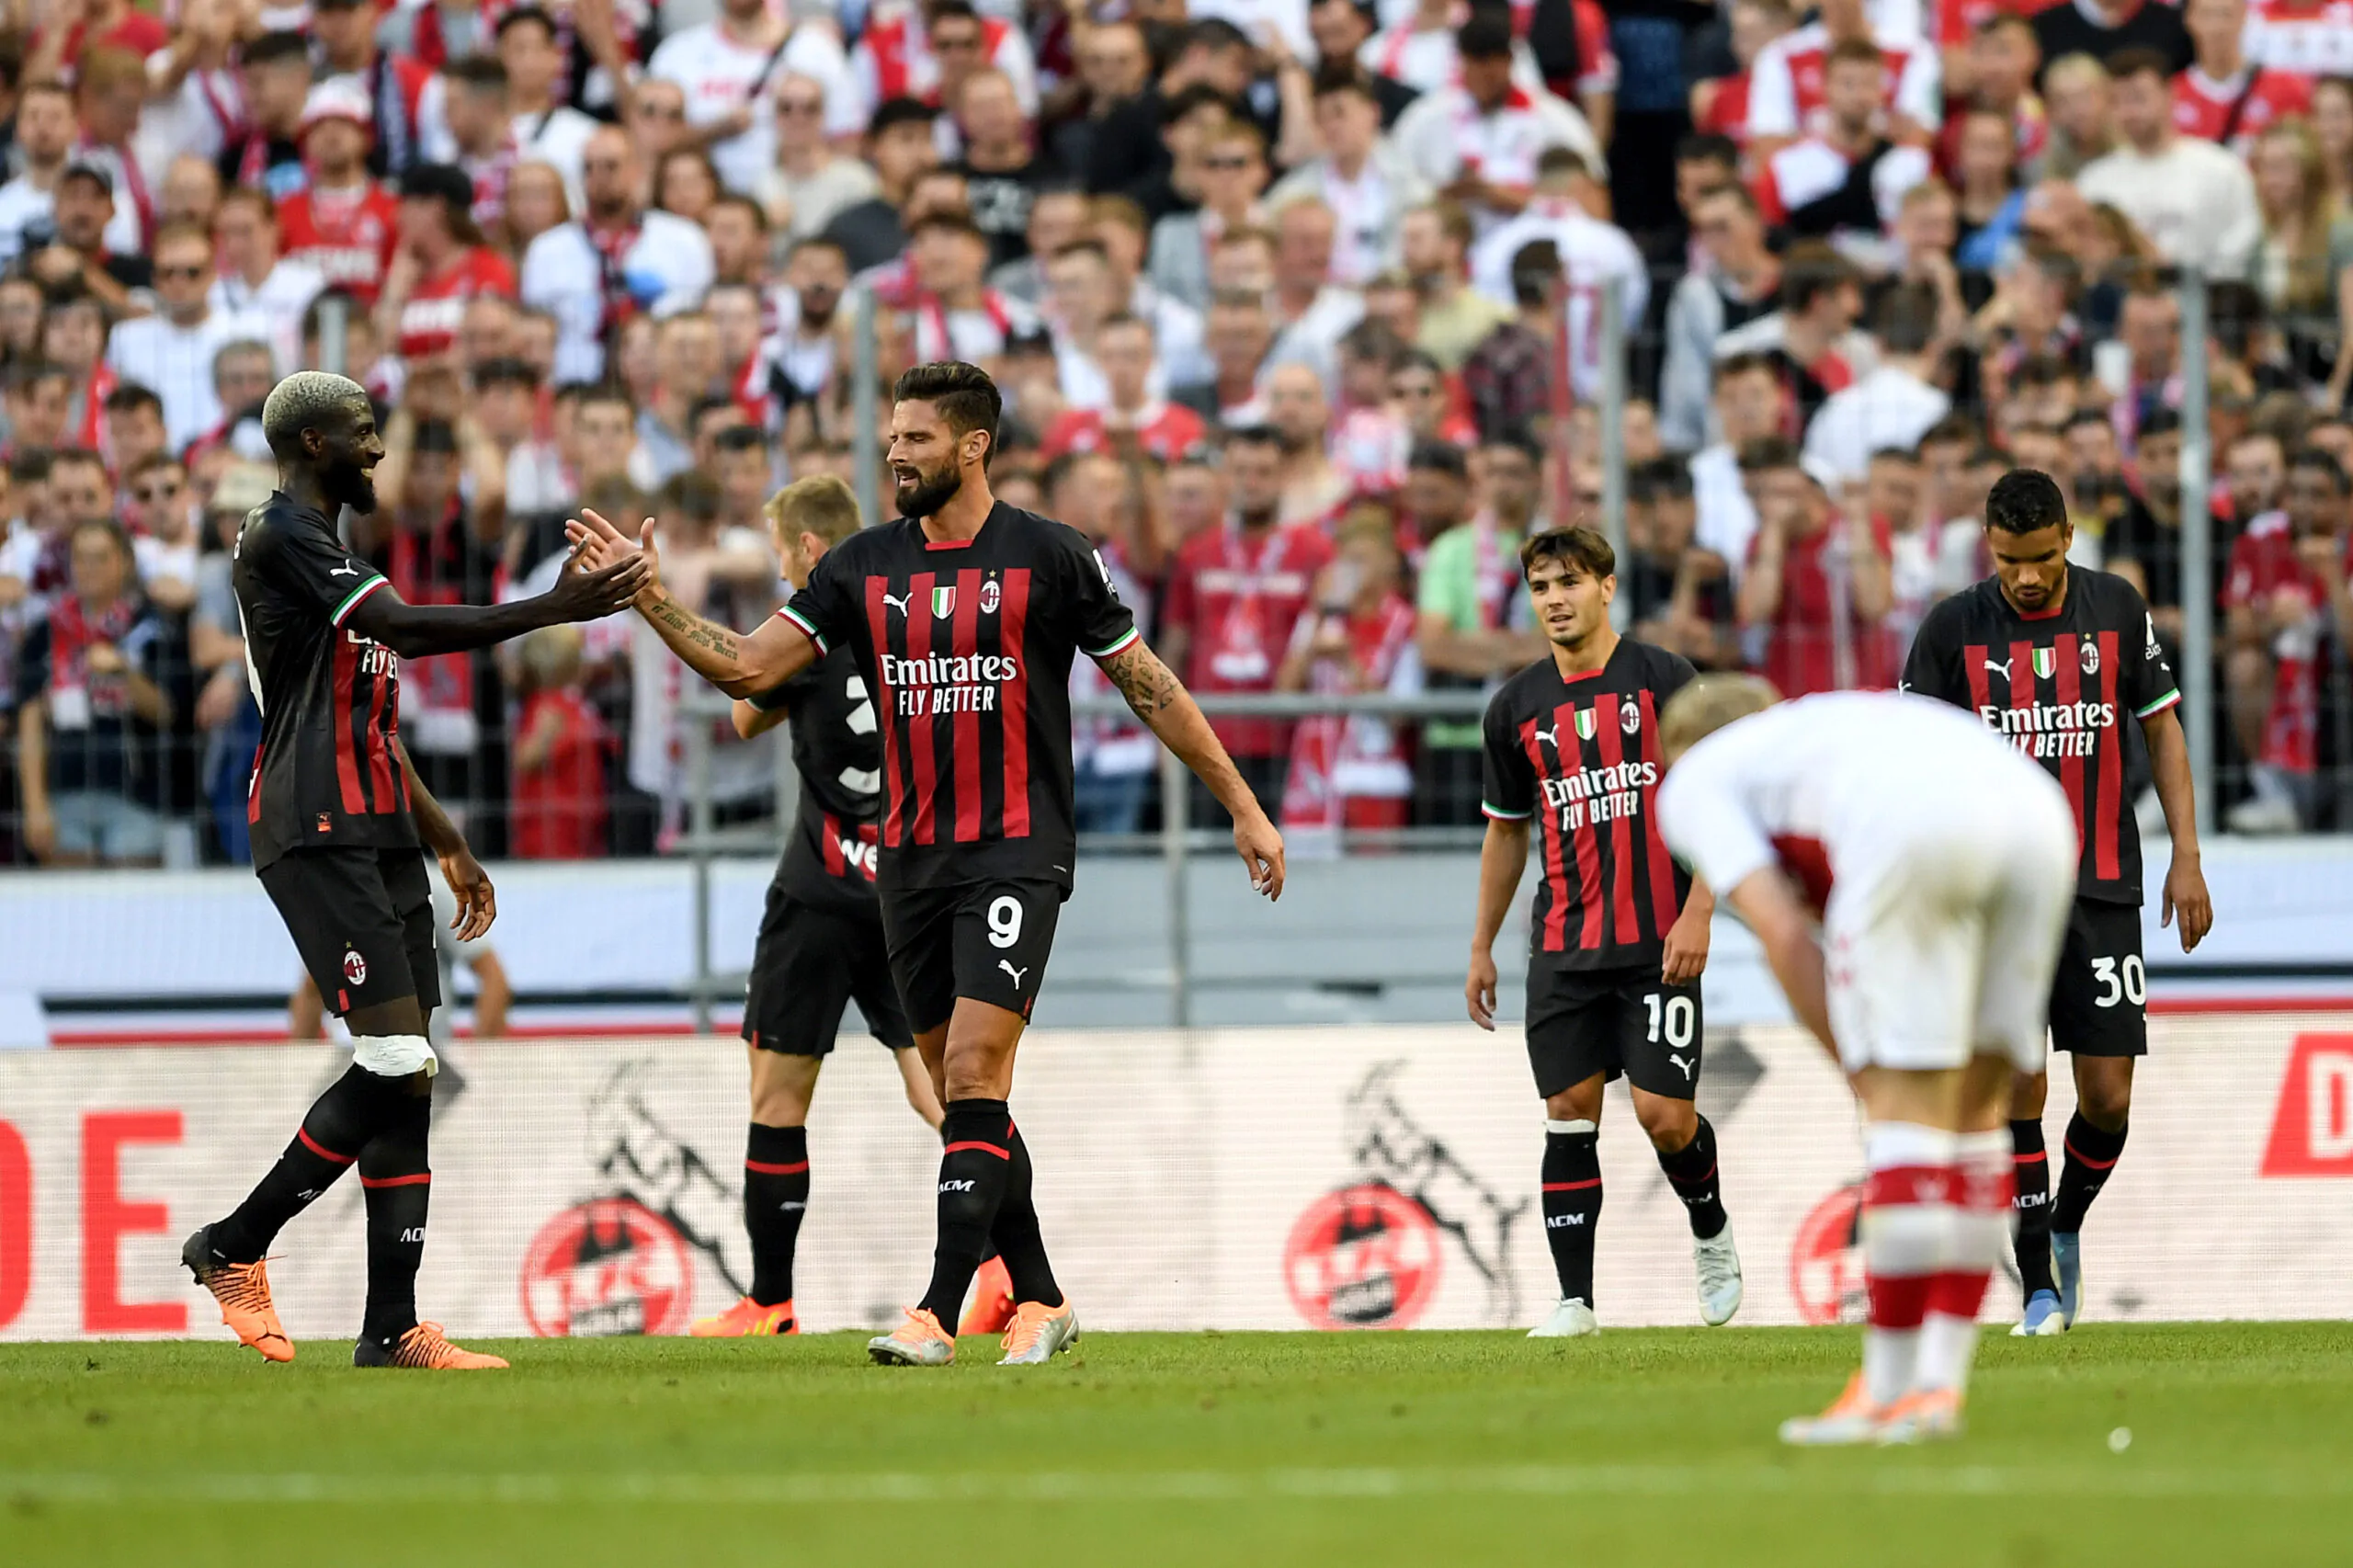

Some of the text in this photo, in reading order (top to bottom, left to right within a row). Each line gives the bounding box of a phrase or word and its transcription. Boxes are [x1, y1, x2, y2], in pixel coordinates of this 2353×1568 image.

[880, 651, 1017, 686] Emirates
[899, 686, 995, 716] FLY BETTER
[1979, 699, 2115, 733] Emirates
[2033, 731, 2095, 757] BETTER
[1541, 759, 1657, 808] Emirates
[1563, 790, 1638, 832] FLY BETTER
[987, 895, 1023, 949] 9
[2091, 954, 2146, 1007] 30
[1643, 993, 1695, 1048] 10
[938, 1179, 976, 1195] ACM
[2012, 1191, 2046, 1209] ACM
[1547, 1212, 1585, 1228] ACM
